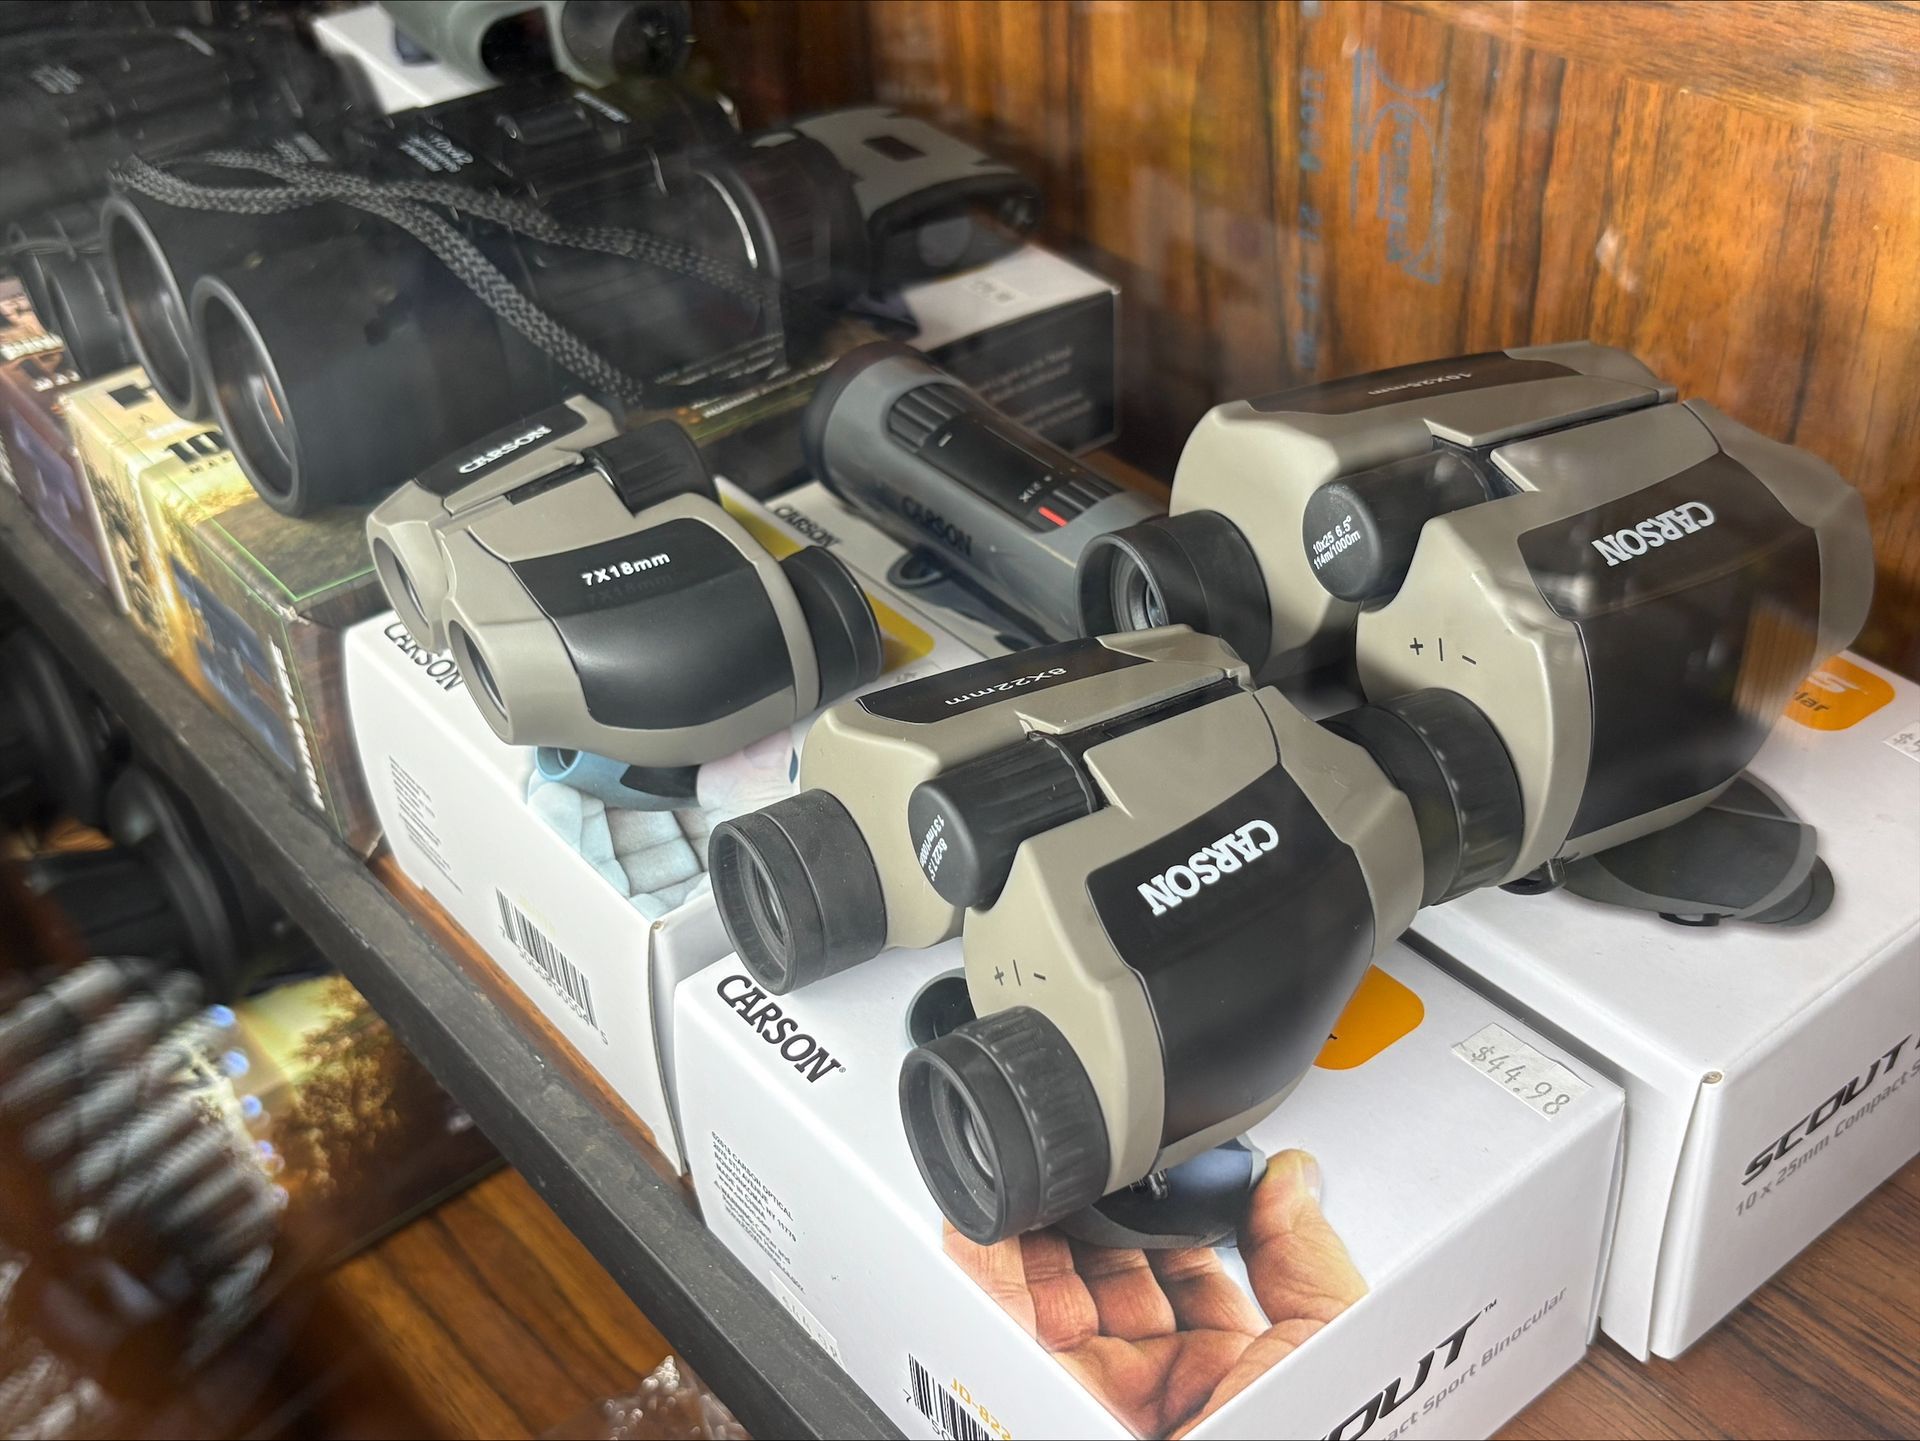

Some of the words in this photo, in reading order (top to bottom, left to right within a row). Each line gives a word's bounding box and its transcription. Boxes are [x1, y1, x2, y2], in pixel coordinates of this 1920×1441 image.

[459, 425, 552, 474] CARSON
[774, 507, 842, 547] CARSON
[902, 496, 972, 556] CARSON
[1312, 530, 1335, 555] 10x25
[1313, 530, 1361, 570] 114m/1000m
[1591, 501, 1715, 567] CARSON
[581, 553, 671, 586] 7X18mm
[944, 667, 1068, 706] 8X22mm
[1793, 691, 1830, 712] lar
[1136, 819, 1280, 917] CARSON
[1472, 1046, 1571, 1116] $44.98
[1741, 1034, 1913, 1186] SCOUT
[1736, 1191, 1758, 1217] 10
[1775, 1135, 1830, 1186] 25mm
[1833, 1071, 1908, 1139] Compact
[732, 1153, 762, 1187] CARSON
[762, 1185, 794, 1222] OPTICAL
[1383, 1411, 1419, 1440] act
[1422, 1362, 1477, 1416] Sport
[1481, 1287, 1568, 1368] Binocular
